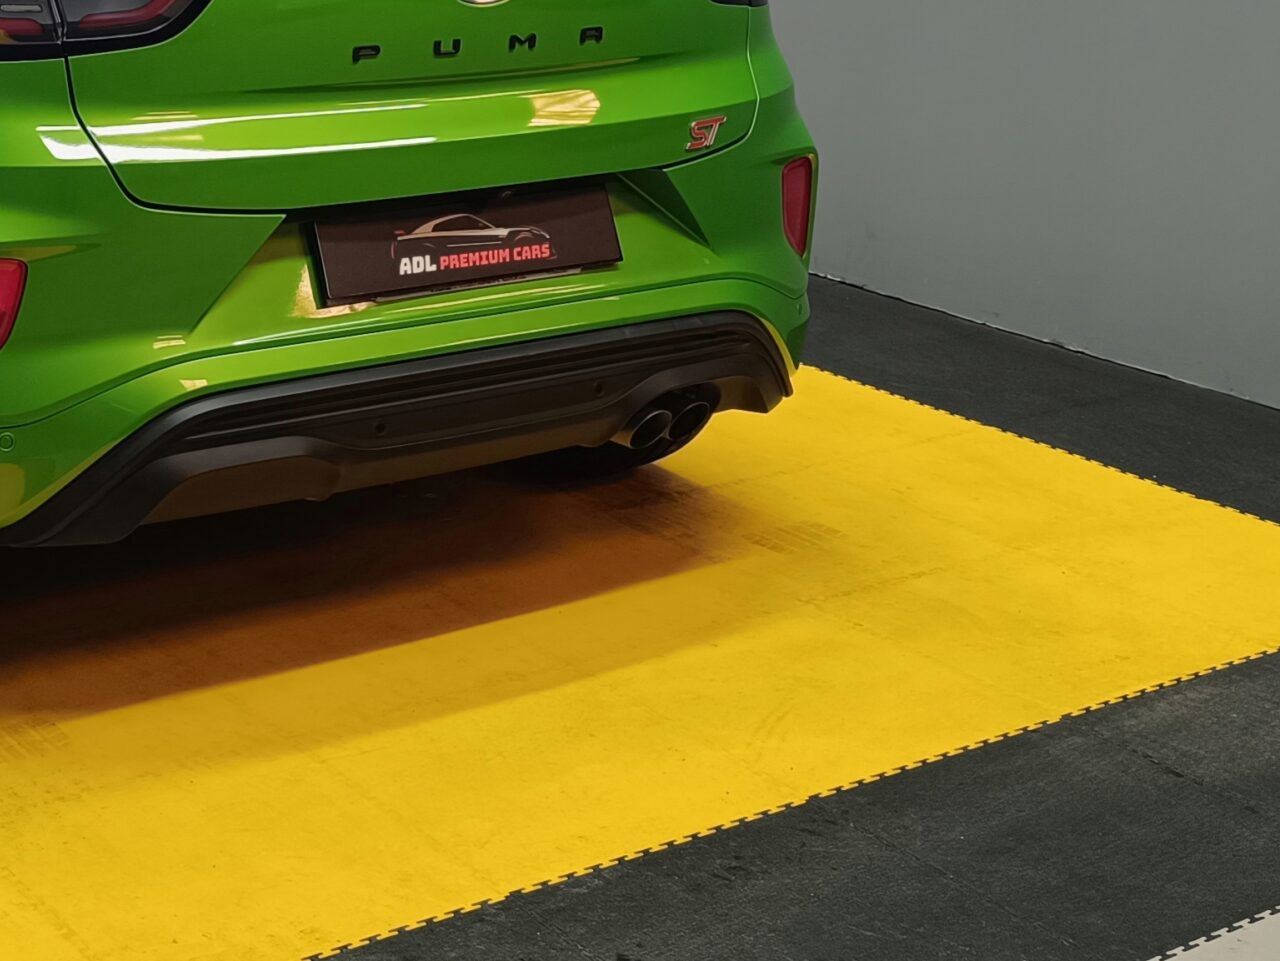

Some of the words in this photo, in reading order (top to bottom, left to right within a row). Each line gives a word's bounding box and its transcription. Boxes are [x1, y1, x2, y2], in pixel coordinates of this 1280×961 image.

[352, 26, 604, 64] PUMA
[686, 116, 726, 150] ST
[399, 255, 437, 275] ADL
[439, 248, 510, 270] PREMIUM
[513, 243, 550, 261] CARS
